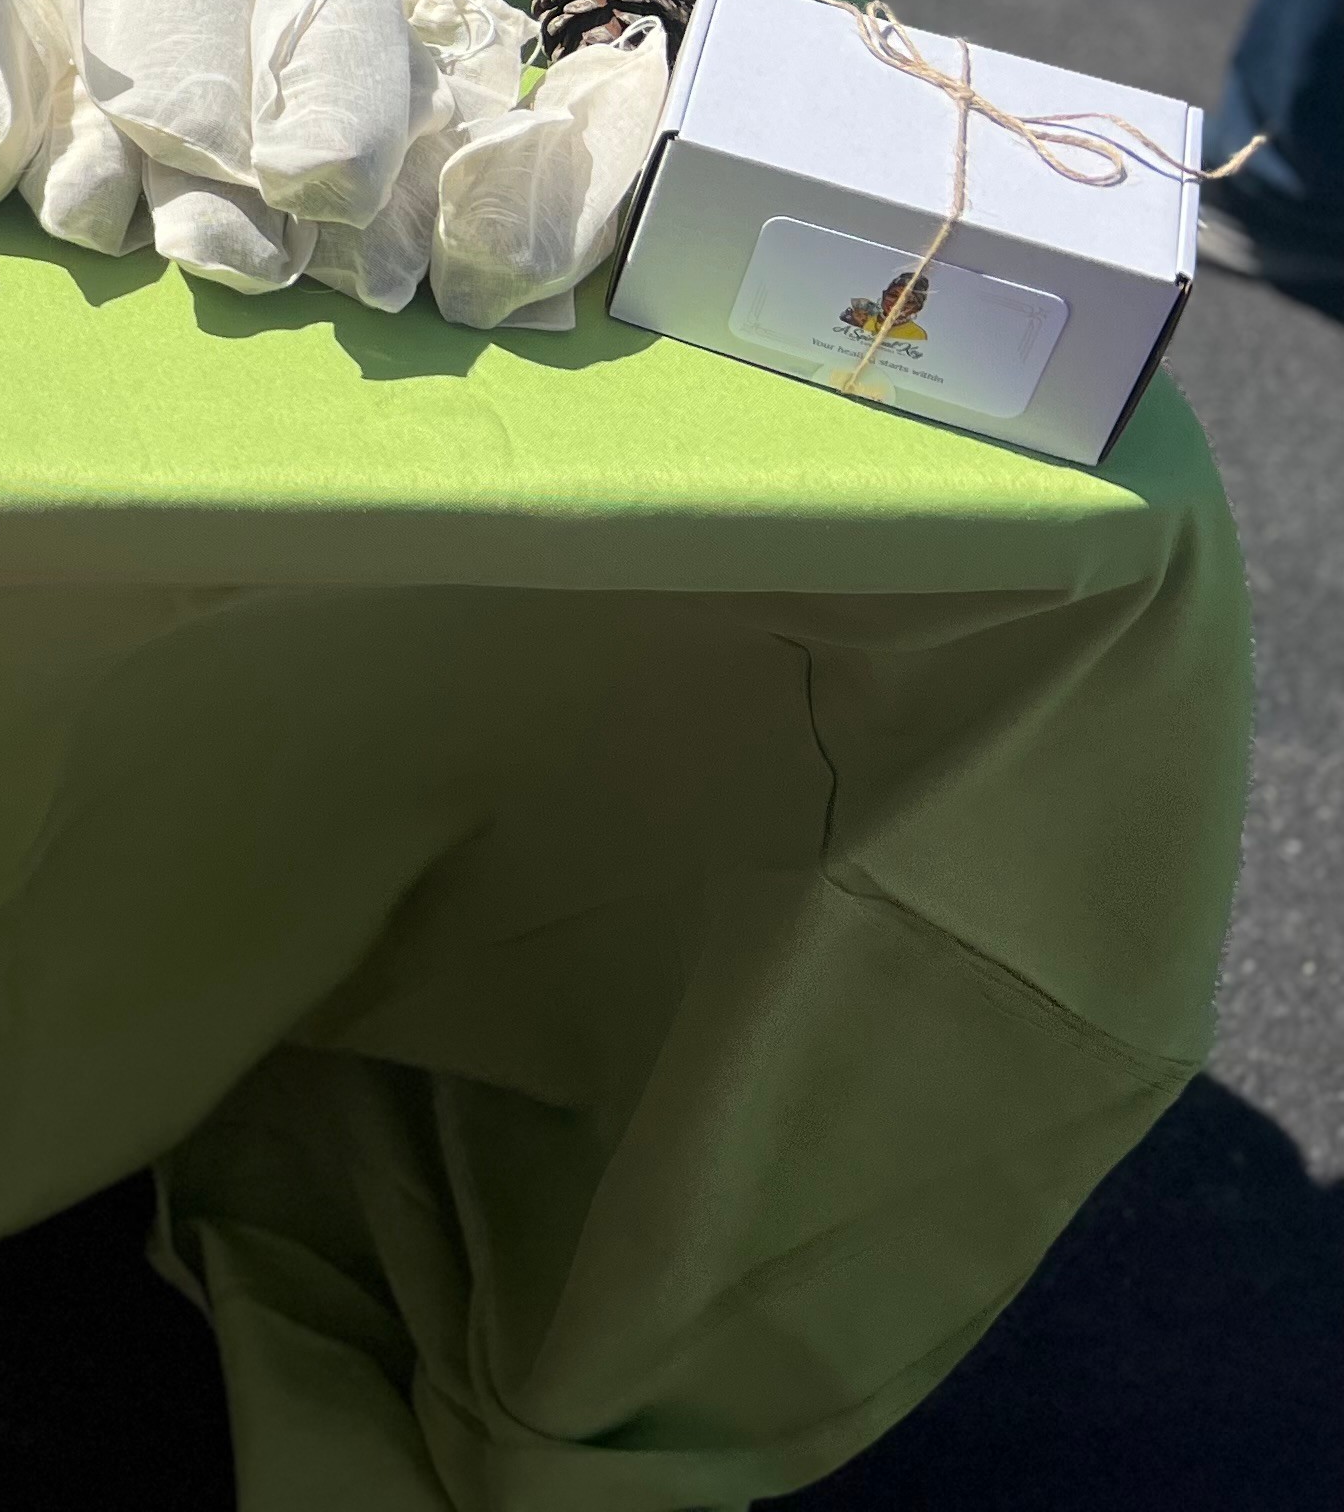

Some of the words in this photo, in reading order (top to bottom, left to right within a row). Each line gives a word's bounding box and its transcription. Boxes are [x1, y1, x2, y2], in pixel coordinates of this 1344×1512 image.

[831, 325, 851, 336] A
[812, 338, 835, 351] Your
[879, 359, 909, 373] starts
[912, 368, 945, 384] within
